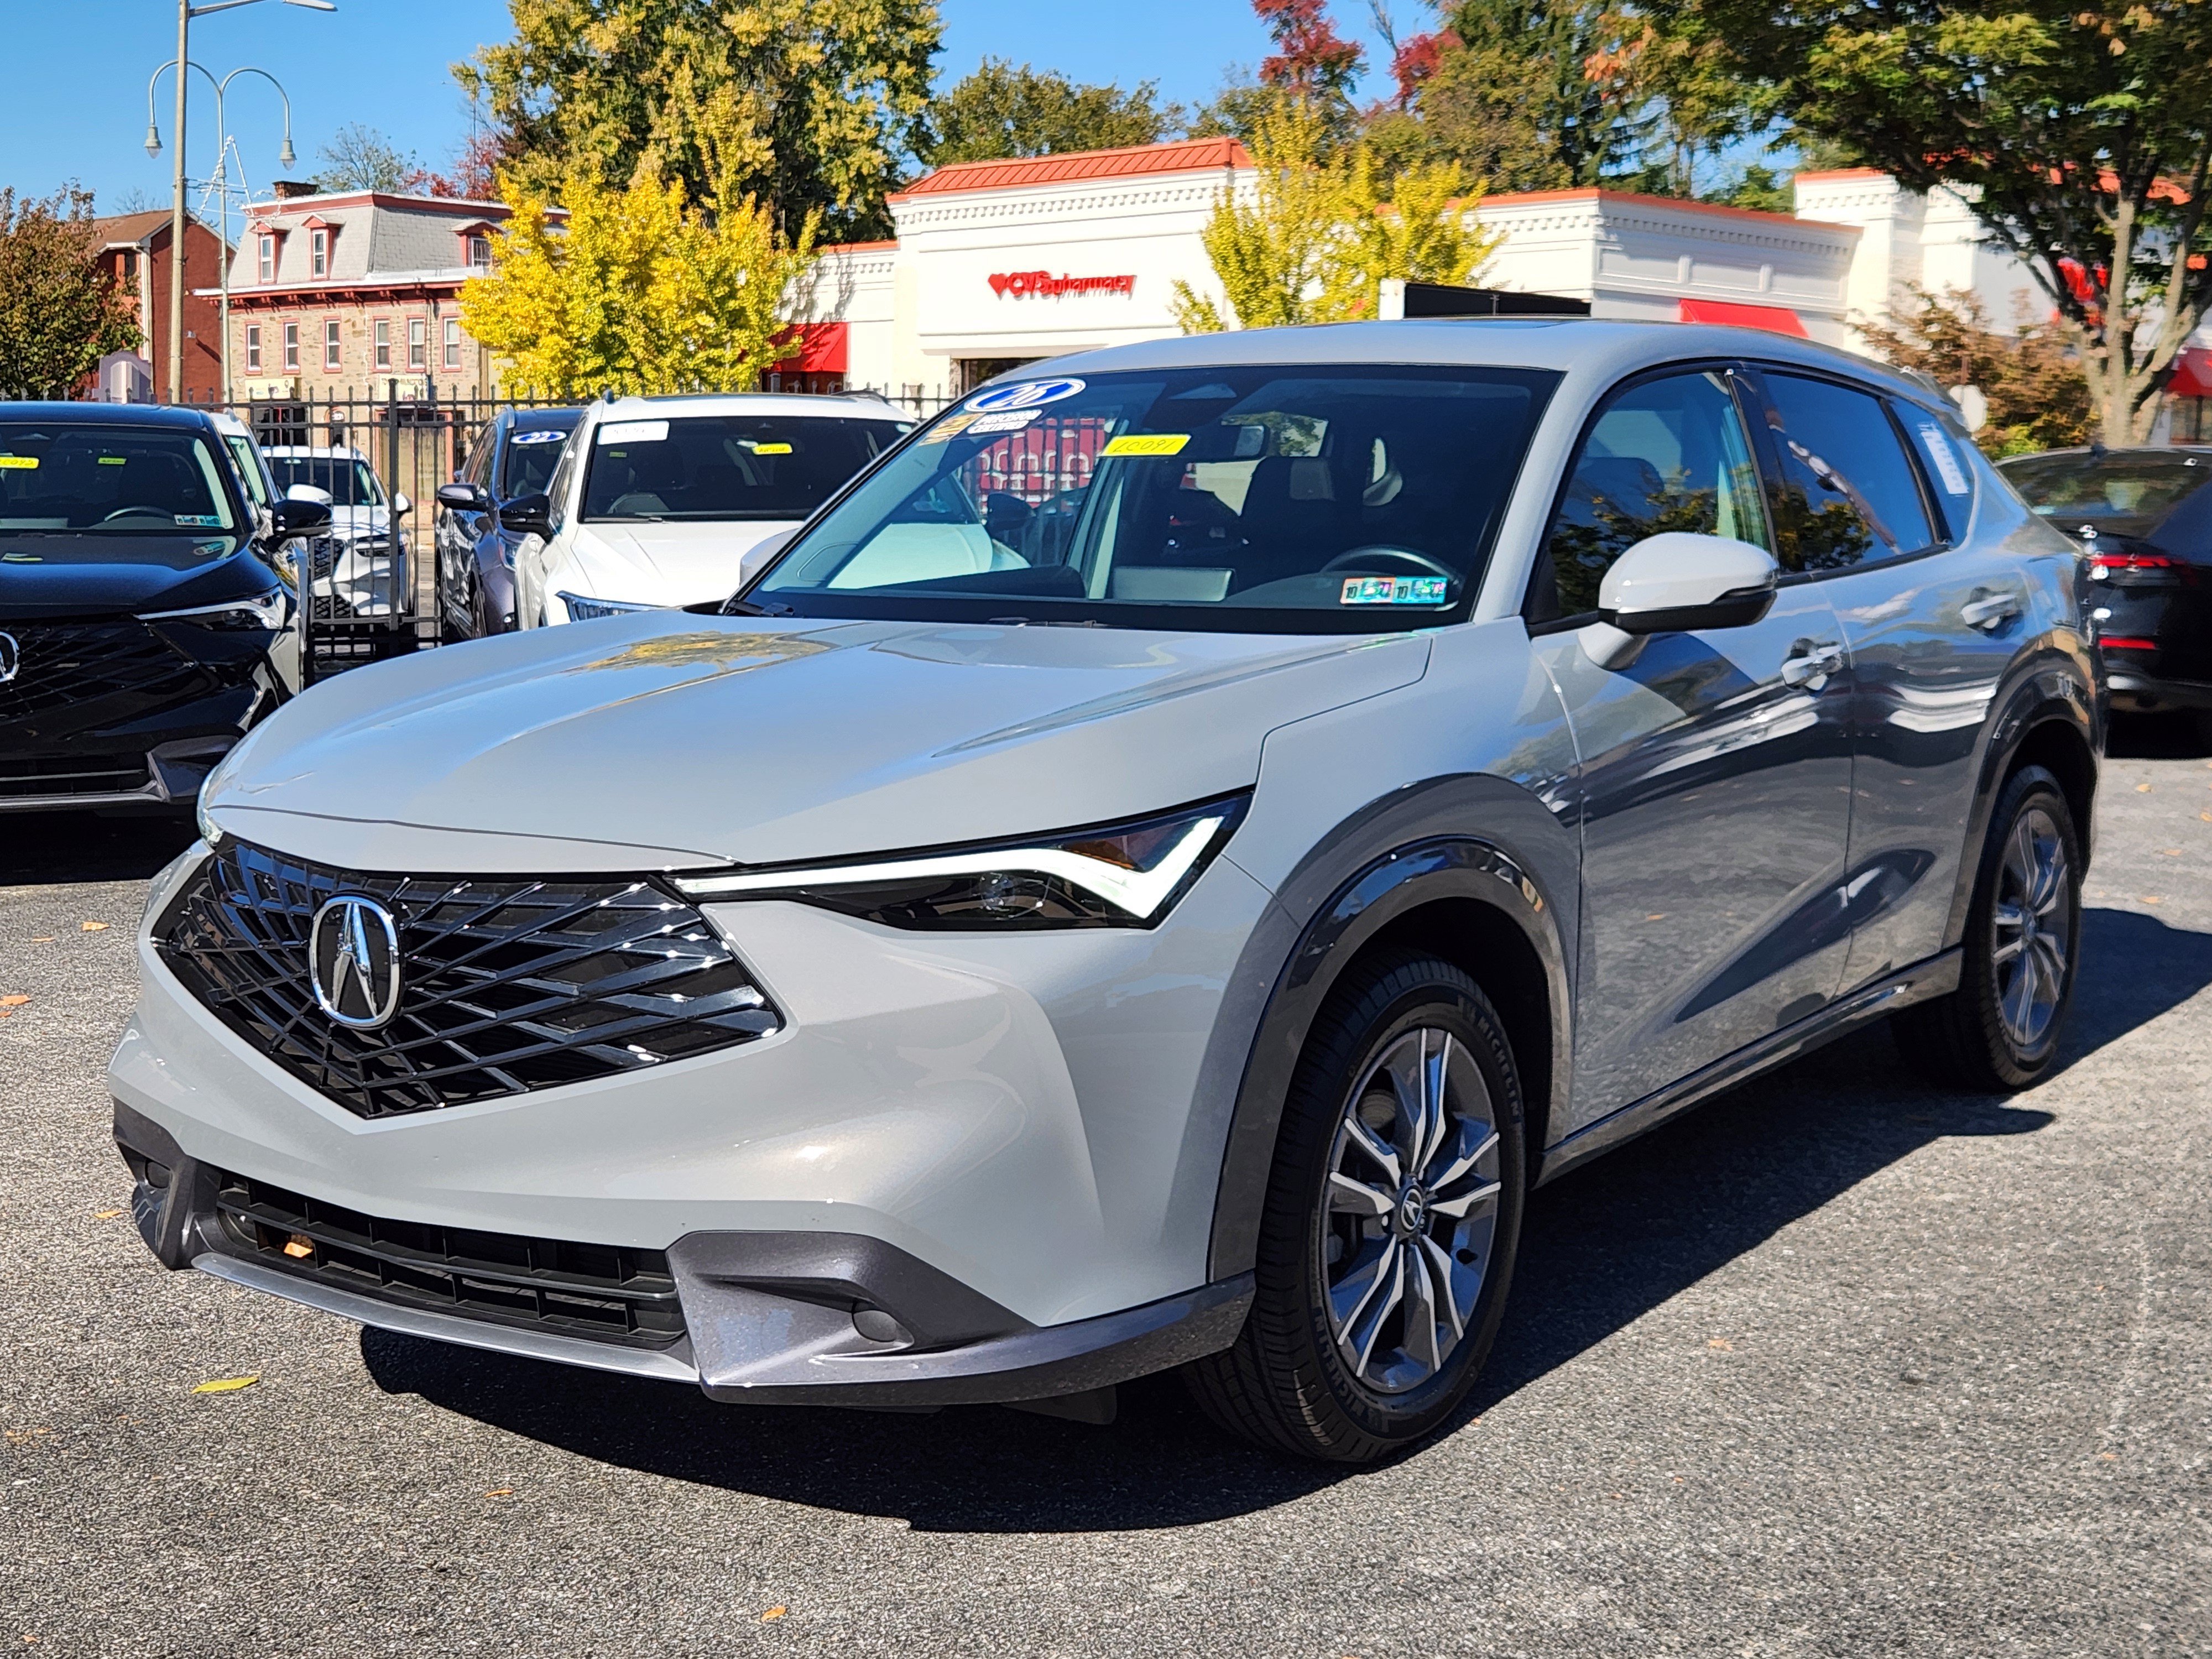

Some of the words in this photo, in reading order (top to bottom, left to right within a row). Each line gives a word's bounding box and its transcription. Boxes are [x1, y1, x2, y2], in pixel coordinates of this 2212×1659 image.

[987, 383, 1057, 408] 26
[525, 431, 553, 442] 22
[1477, 1016, 1520, 1117] MICHELIN
[1314, 1314, 1366, 1417] MICHELIN
